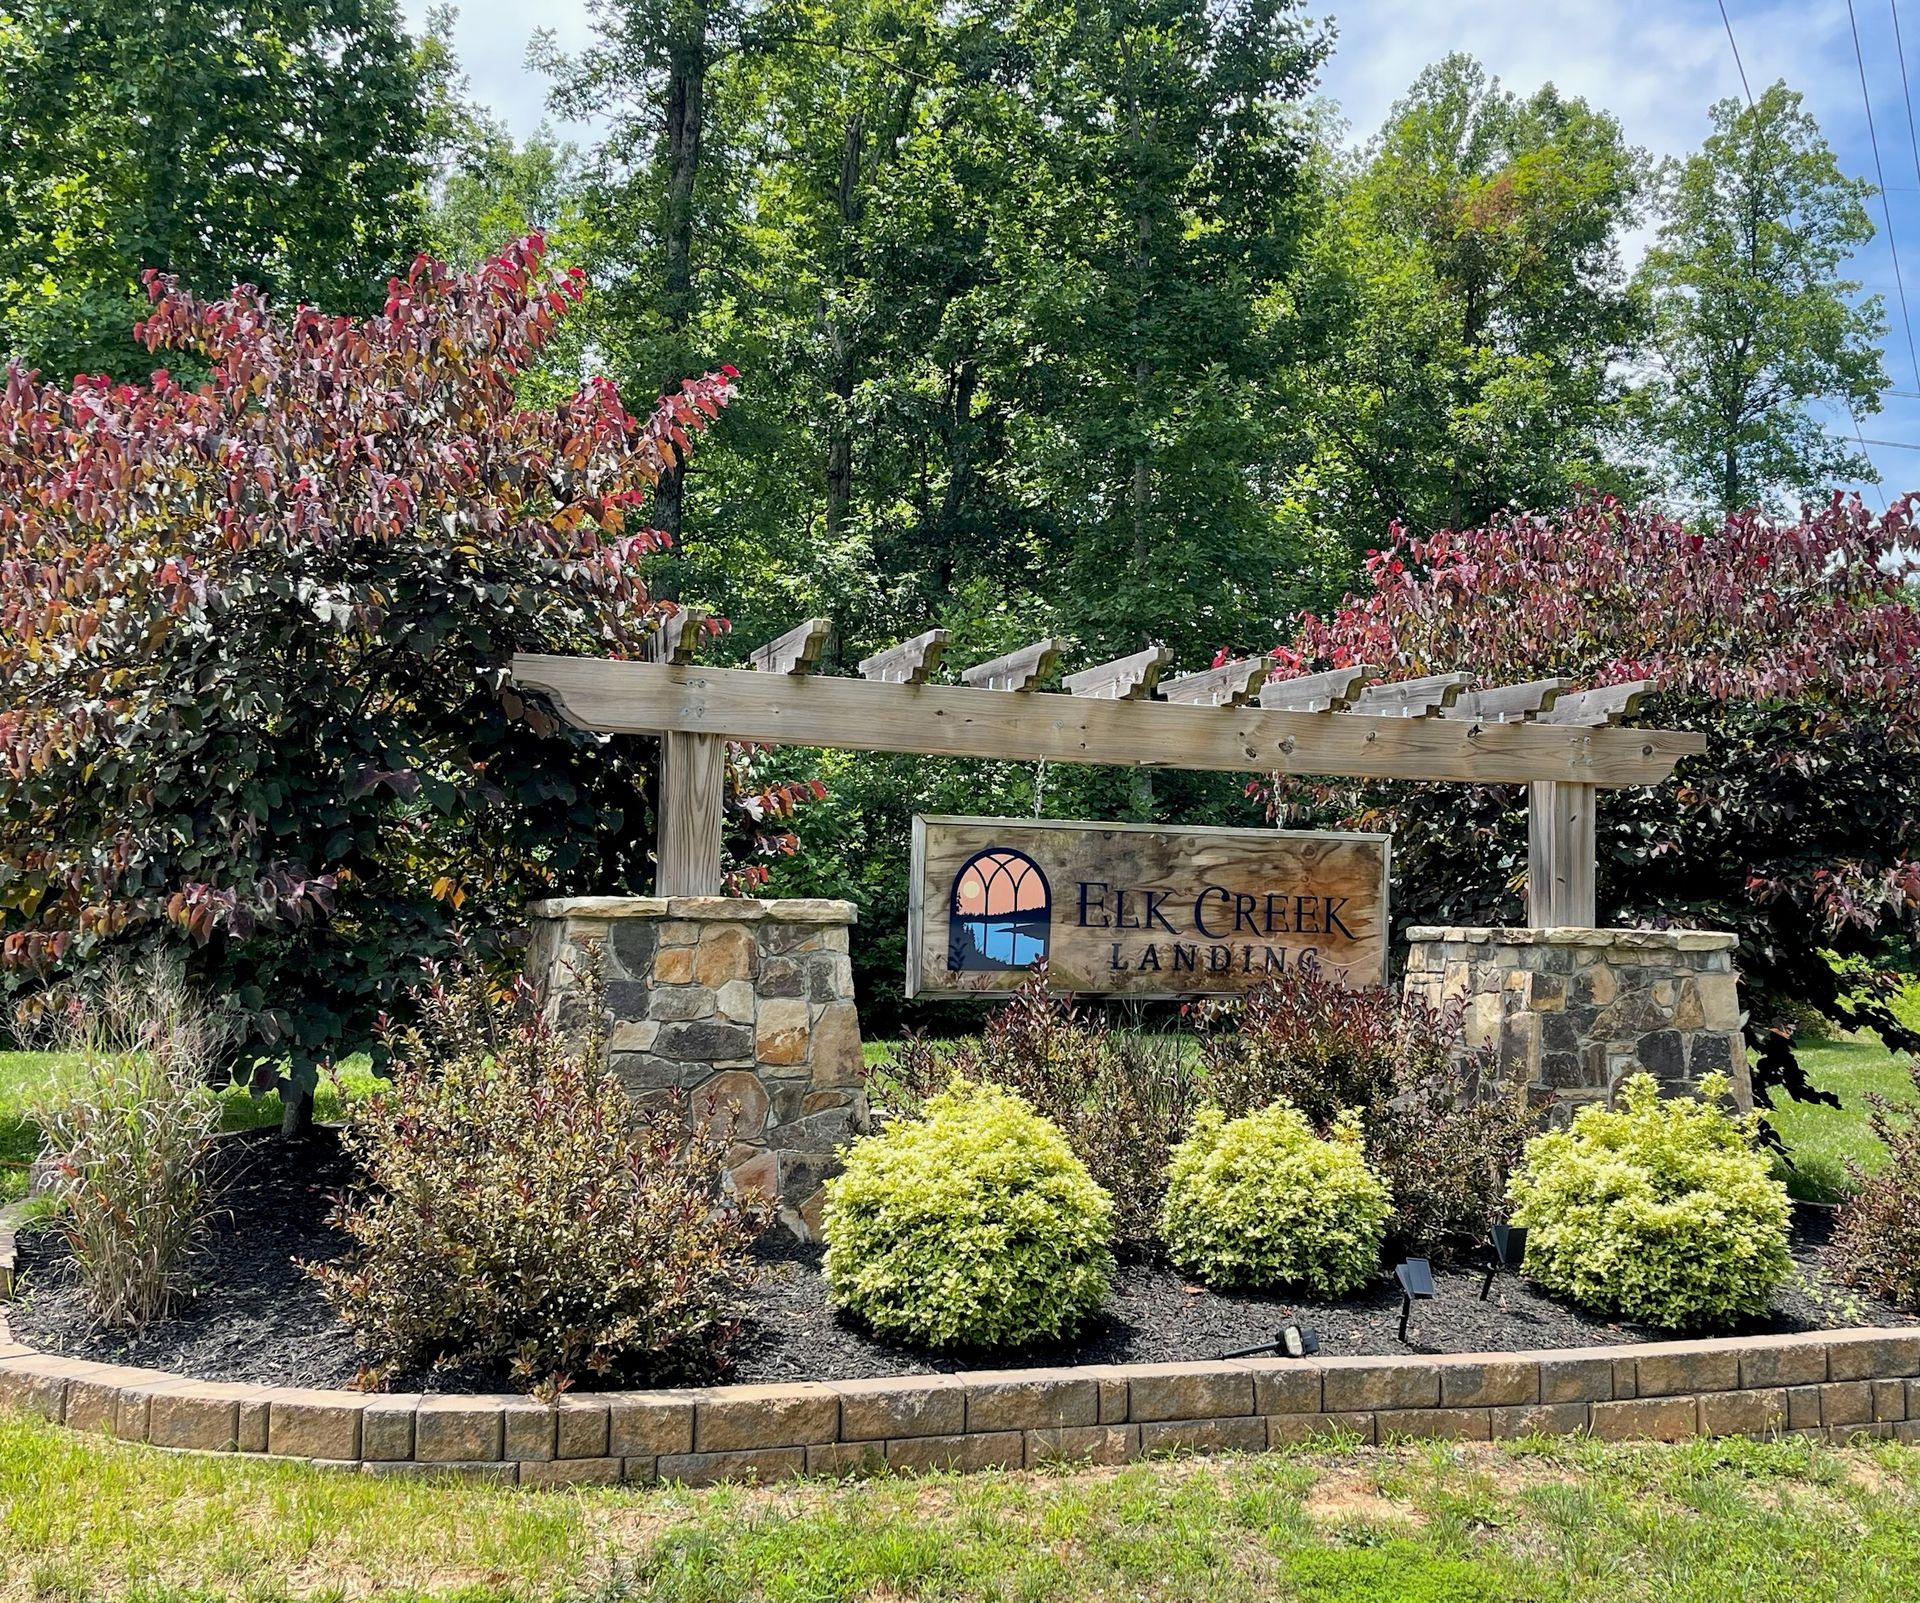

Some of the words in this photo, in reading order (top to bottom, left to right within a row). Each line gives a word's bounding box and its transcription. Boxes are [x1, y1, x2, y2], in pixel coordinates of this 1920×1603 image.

[1075, 881, 1184, 935] ELK
[1195, 887, 1359, 941] CREEK
[1110, 943, 1319, 973] LANDING
